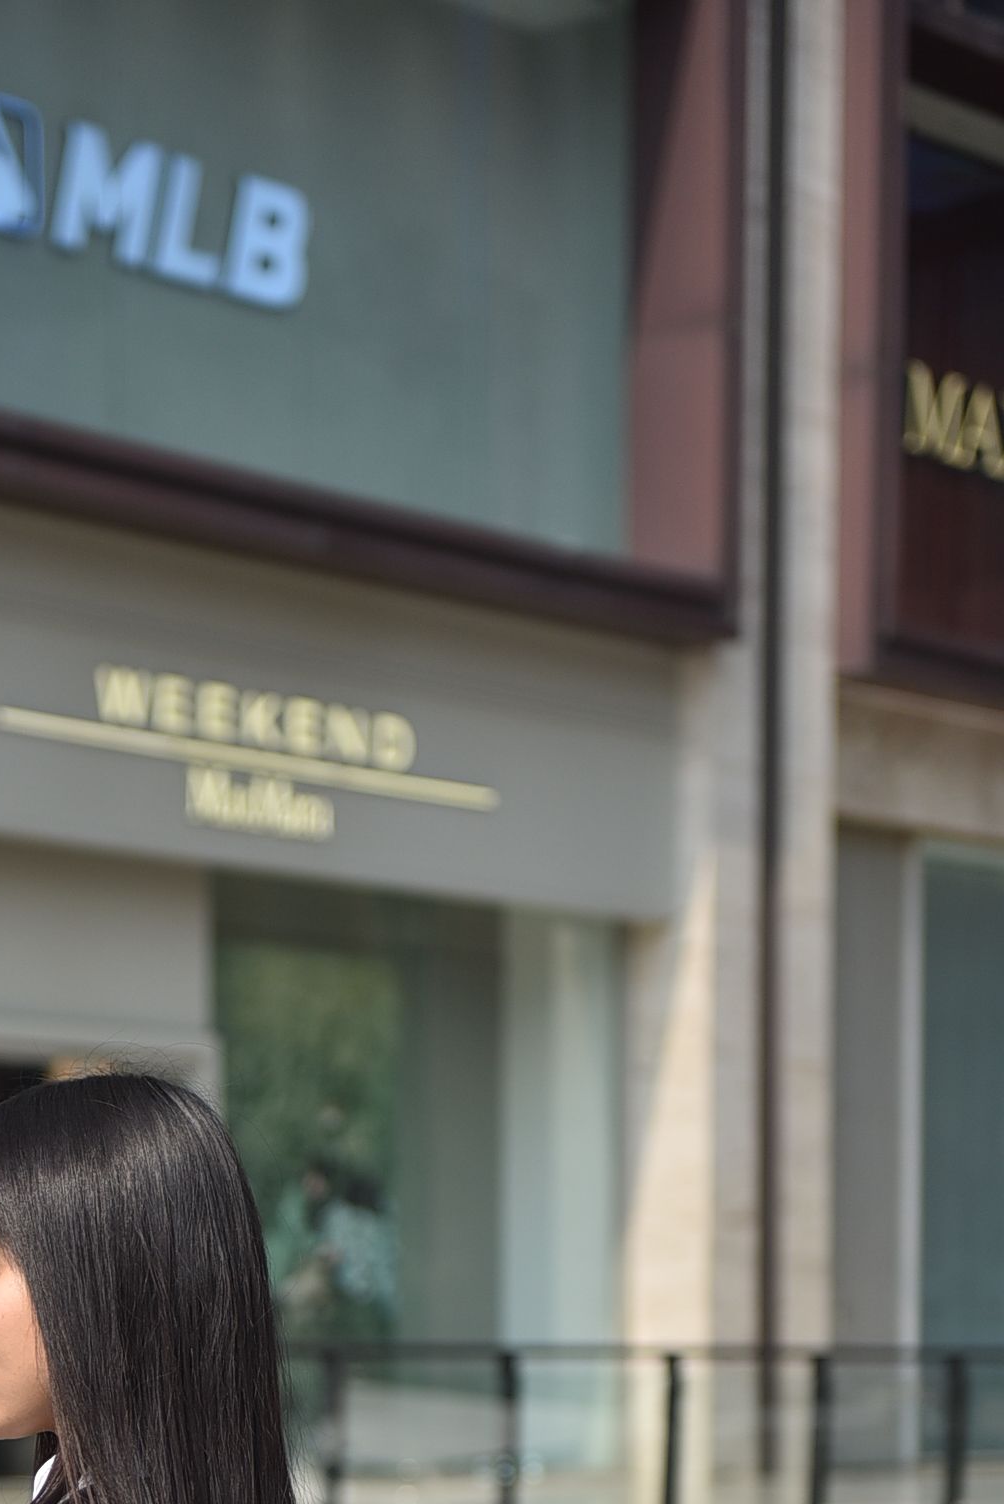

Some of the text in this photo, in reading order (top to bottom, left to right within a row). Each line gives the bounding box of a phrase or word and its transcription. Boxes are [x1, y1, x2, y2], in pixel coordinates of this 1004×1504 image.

[51, 119, 310, 310] MLB
[904, 359, 1004, 480] MA
[95, 664, 417, 773] WEEKEND
